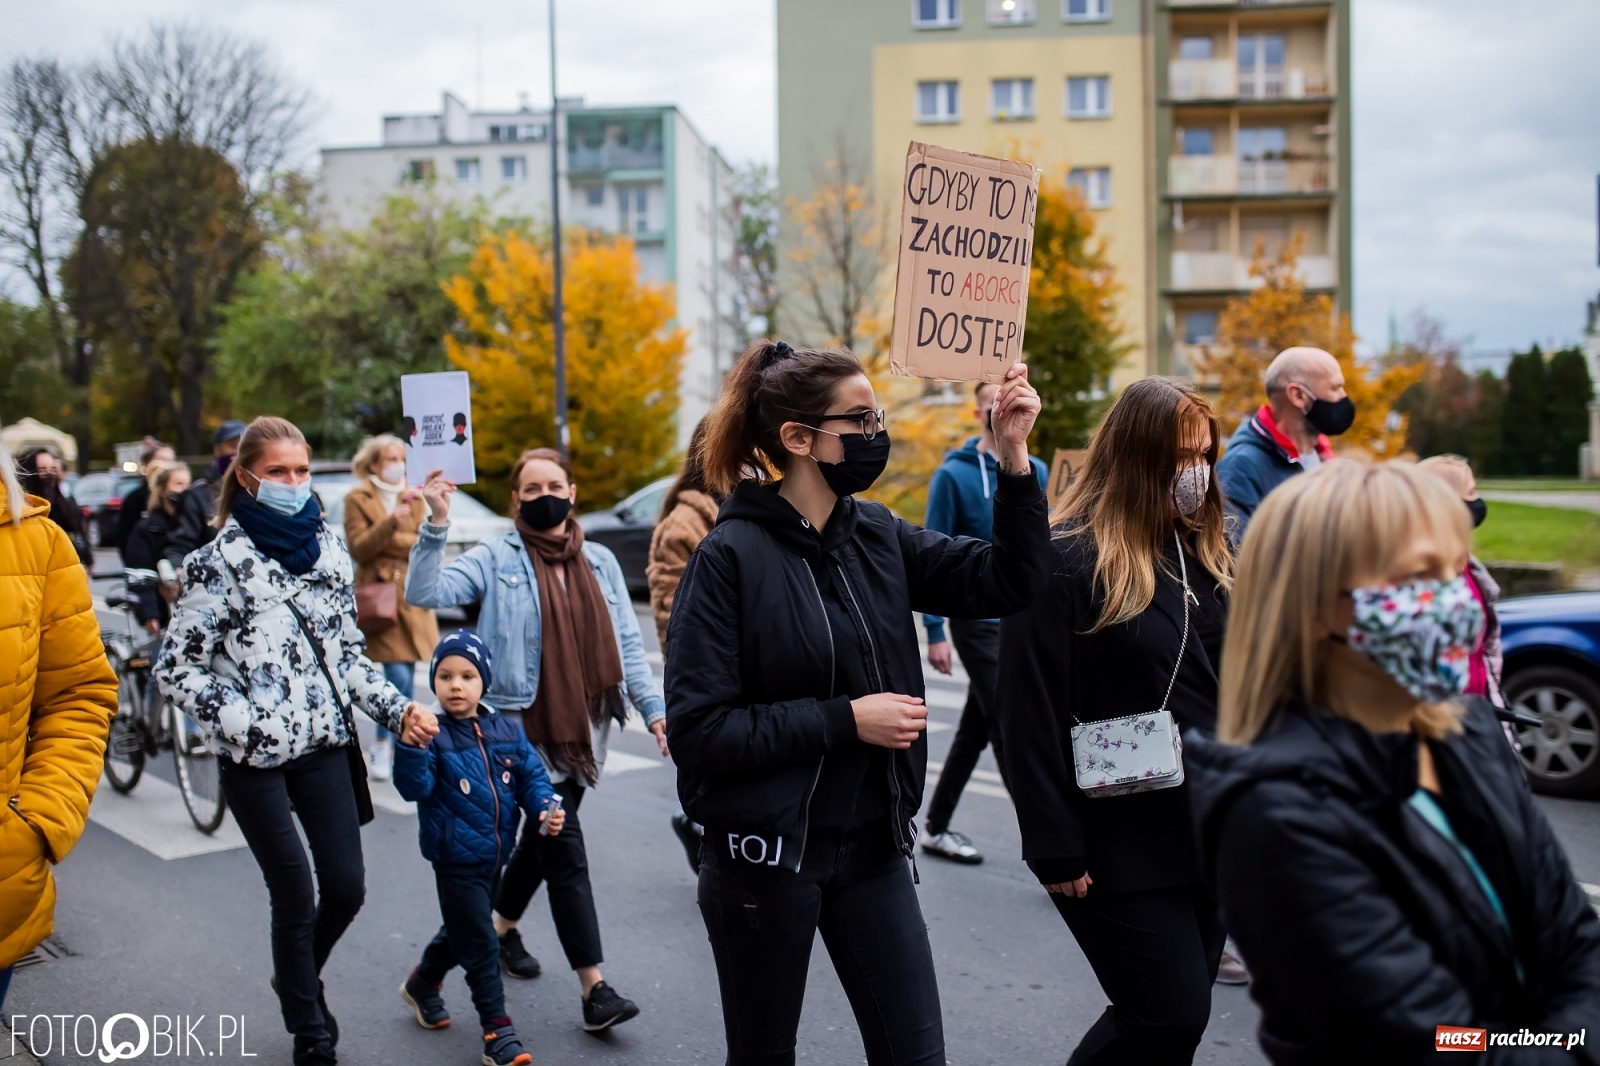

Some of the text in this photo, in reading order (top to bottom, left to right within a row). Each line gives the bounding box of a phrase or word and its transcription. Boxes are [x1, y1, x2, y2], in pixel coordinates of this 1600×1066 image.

[907, 163, 980, 211] GDYBY
[988, 176, 1016, 220] TO
[927, 268, 1020, 304] TO ABORC
